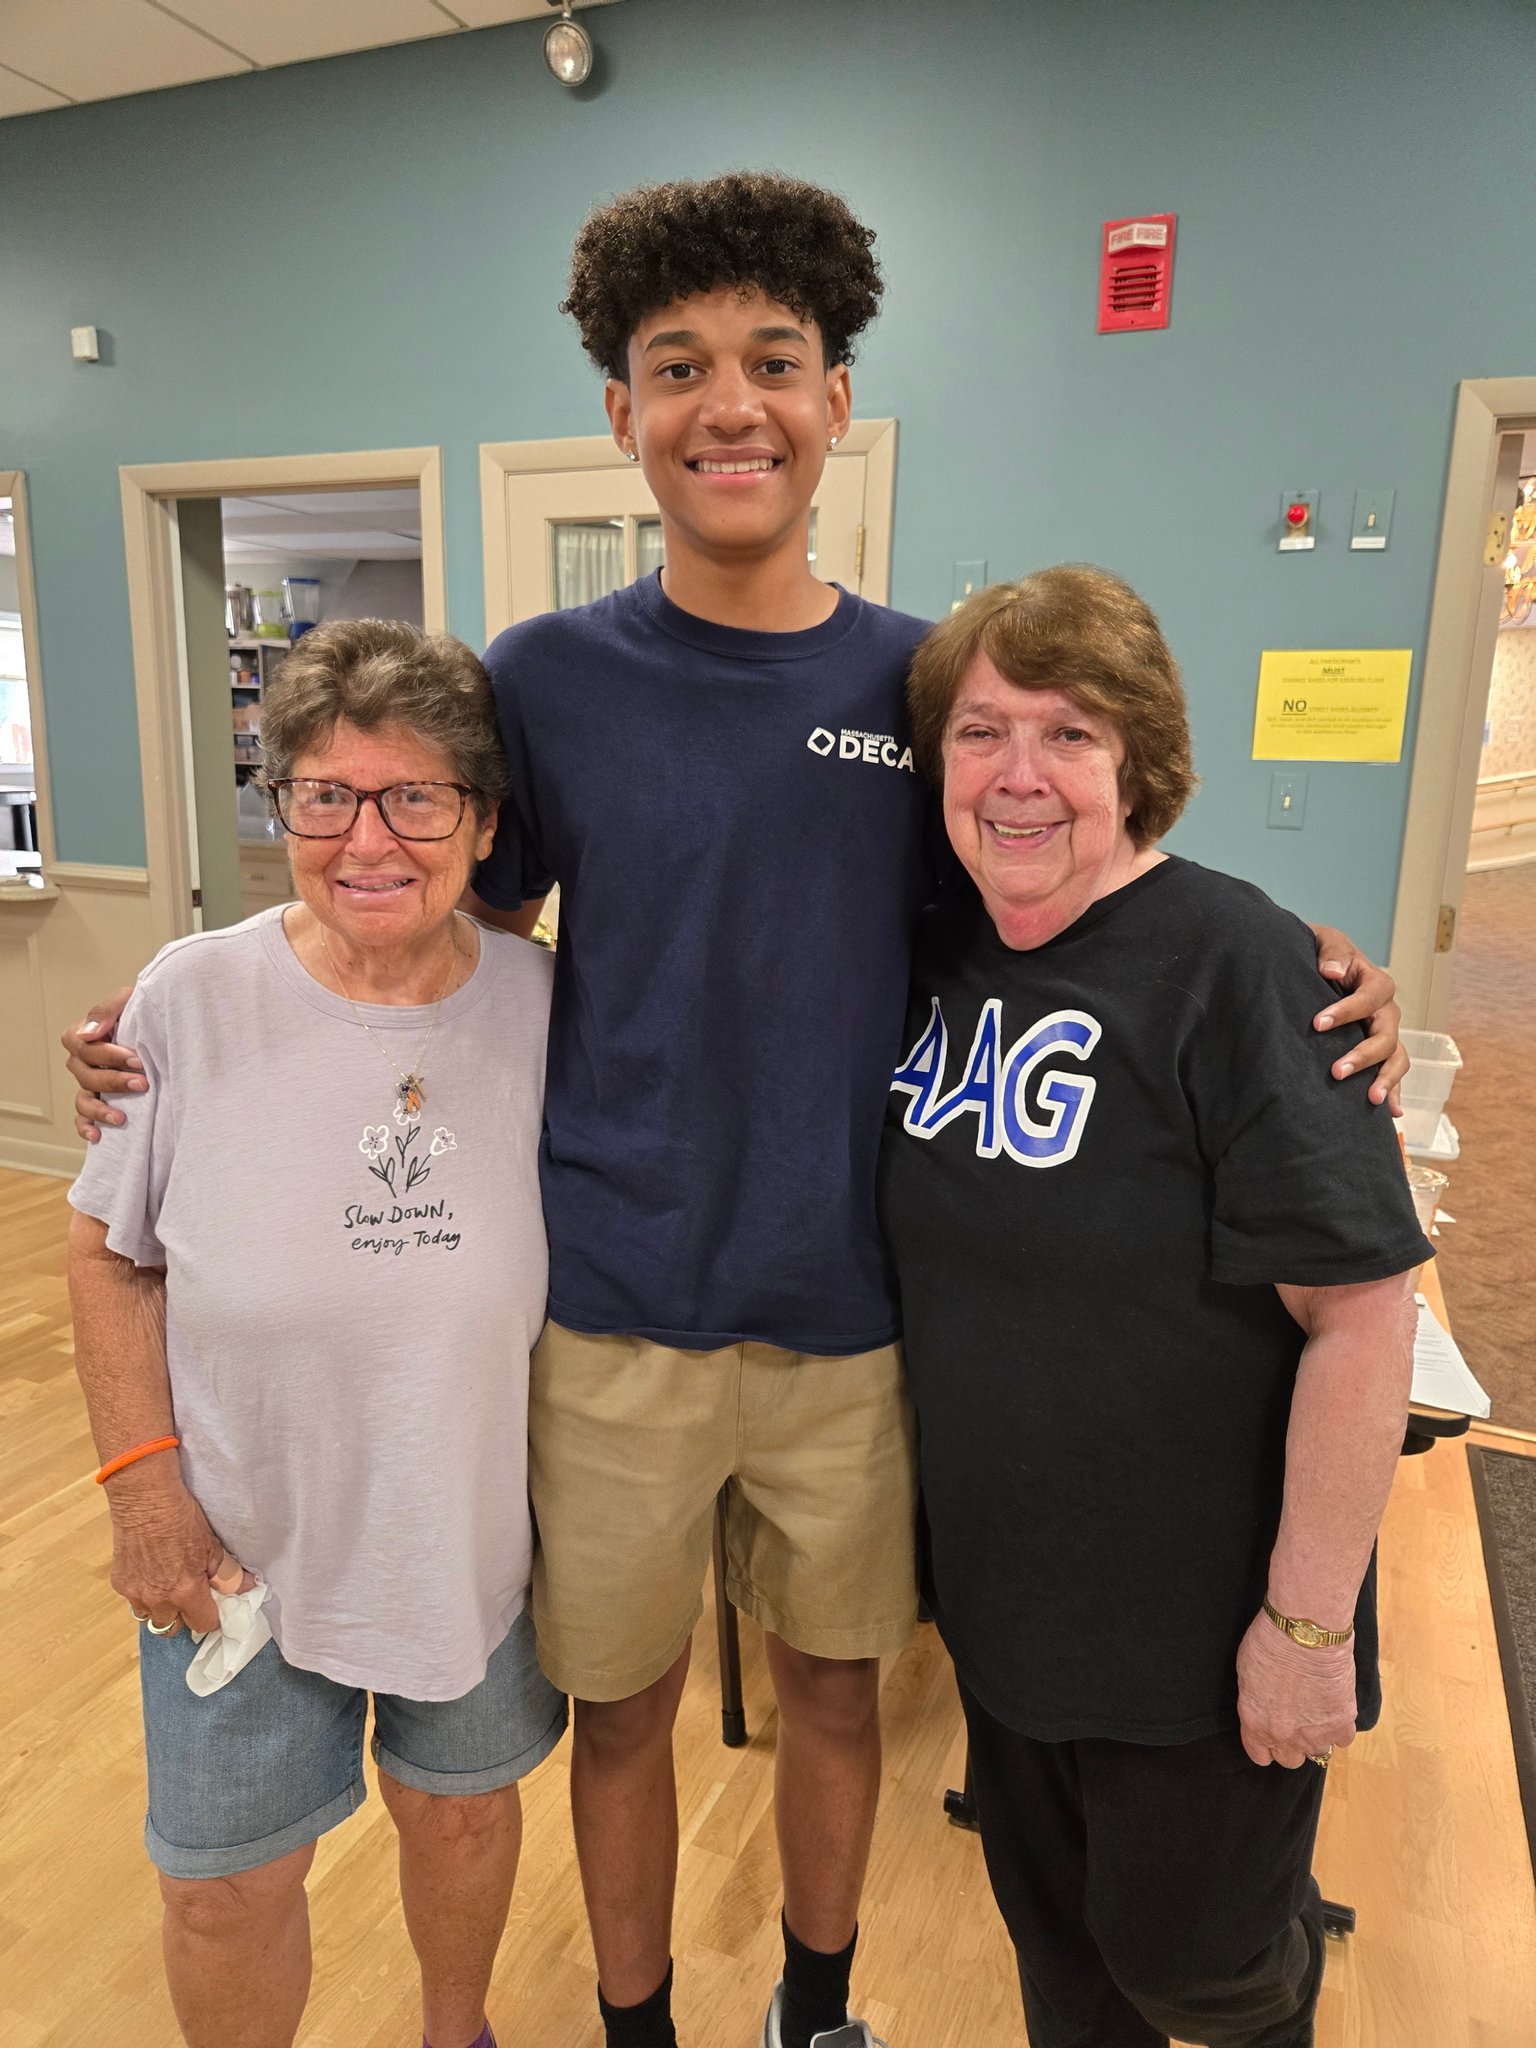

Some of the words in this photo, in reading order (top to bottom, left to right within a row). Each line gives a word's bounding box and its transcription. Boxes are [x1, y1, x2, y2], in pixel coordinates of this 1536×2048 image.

[1111, 227, 1134, 246] FIRE
[1136, 227, 1164, 240] FIRE
[1322, 667, 1346, 675] MUST
[1282, 699, 1308, 713] NO
[840, 728, 895, 743] MASSACHUSETTS
[839, 735, 915, 773] DECA
[344, 1204, 385, 1229] Slow
[351, 1237, 410, 1256] enjoy
[413, 1228, 461, 1251] Today
